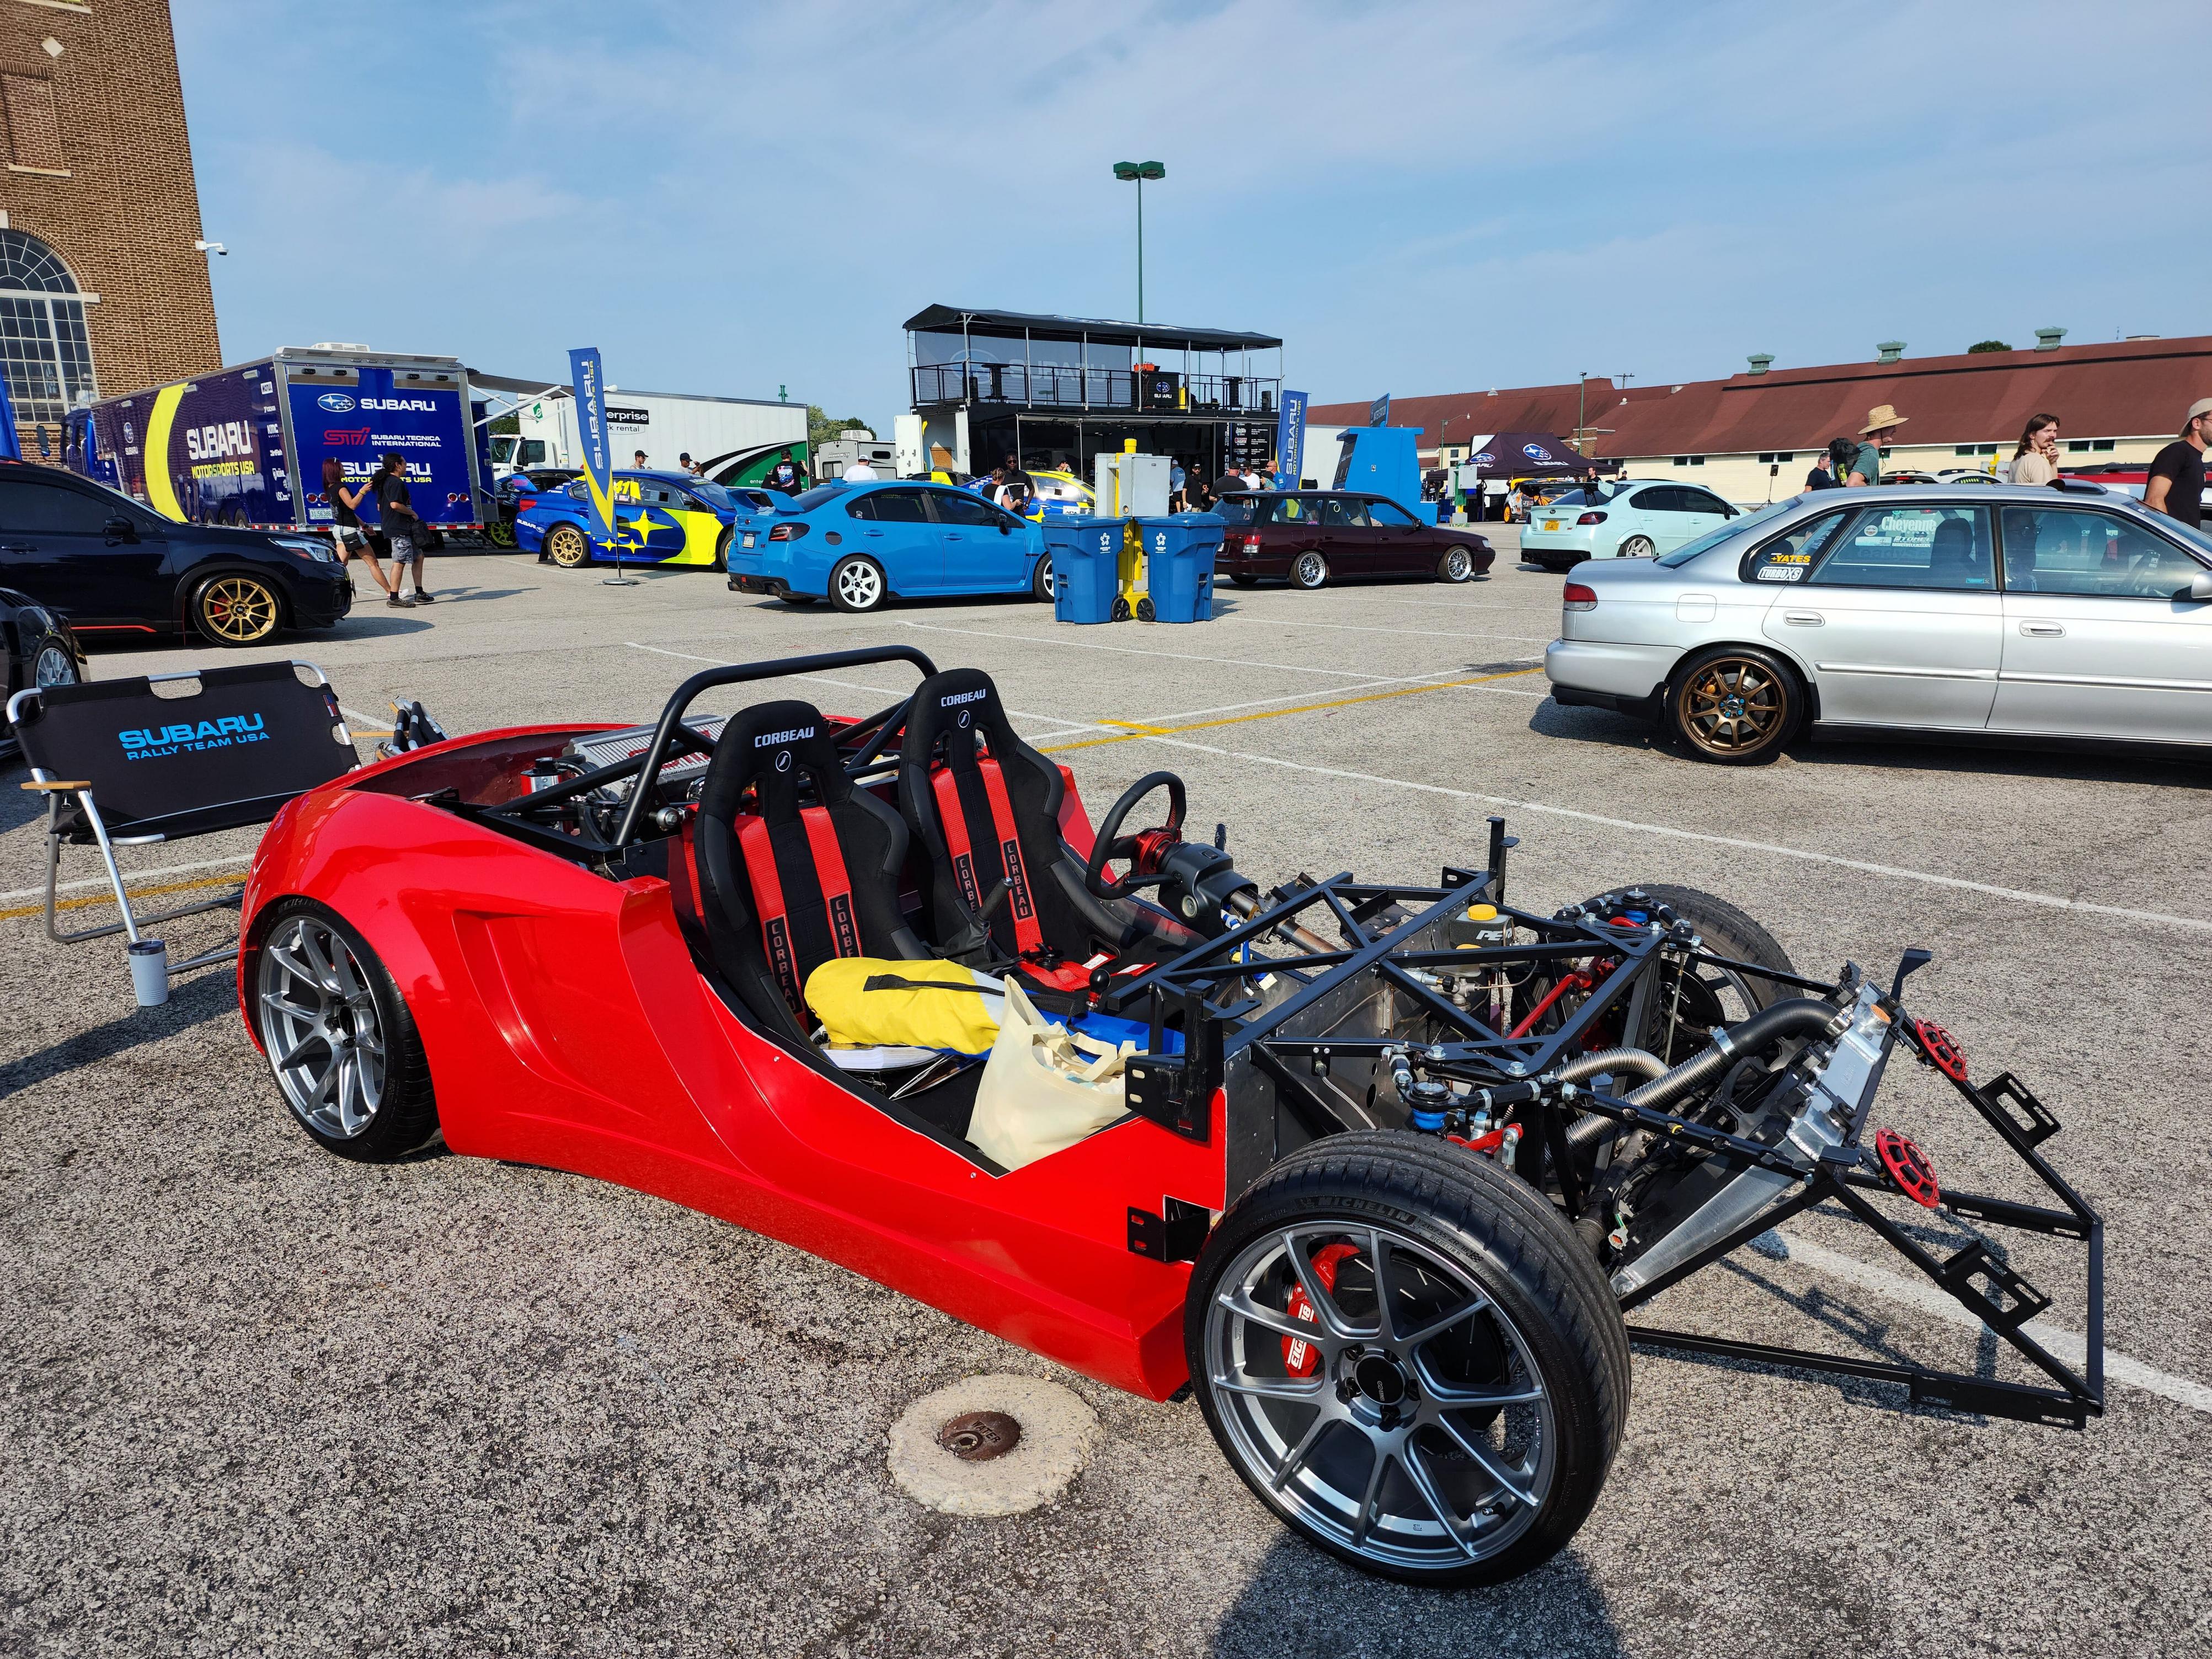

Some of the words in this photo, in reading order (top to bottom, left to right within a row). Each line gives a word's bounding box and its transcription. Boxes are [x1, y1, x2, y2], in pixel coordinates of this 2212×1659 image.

[360, 398, 435, 411] SUBARU
[581, 361, 603, 469] SUBARU
[606, 411, 648, 421] erprise
[186, 420, 252, 460] SUBARU
[1286, 399, 1297, 475] SUBARU
[125, 446, 138, 456] SUBARU
[191, 461, 240, 479] MOTORSPORTS
[240, 460, 255, 475] USA
[342, 462, 431, 475] SUBRU
[613, 480, 631, 495] 41
[1882, 516, 1937, 533] Cheyenne
[941, 688, 986, 707] CORBEAU
[118, 713, 264, 749] SUBARU
[755, 726, 814, 748] CORBEAU
[126, 745, 179, 760] RALLY
[183, 737, 232, 752] TEAM
[235, 732, 270, 743] USA
[959, 858, 976, 911] CORBE
[1007, 844, 1028, 917] CORBEAU
[836, 900, 854, 957] CORBE
[1318, 1197, 1408, 1222] MICHELIN
[971, 1420, 1001, 1443] WATER
